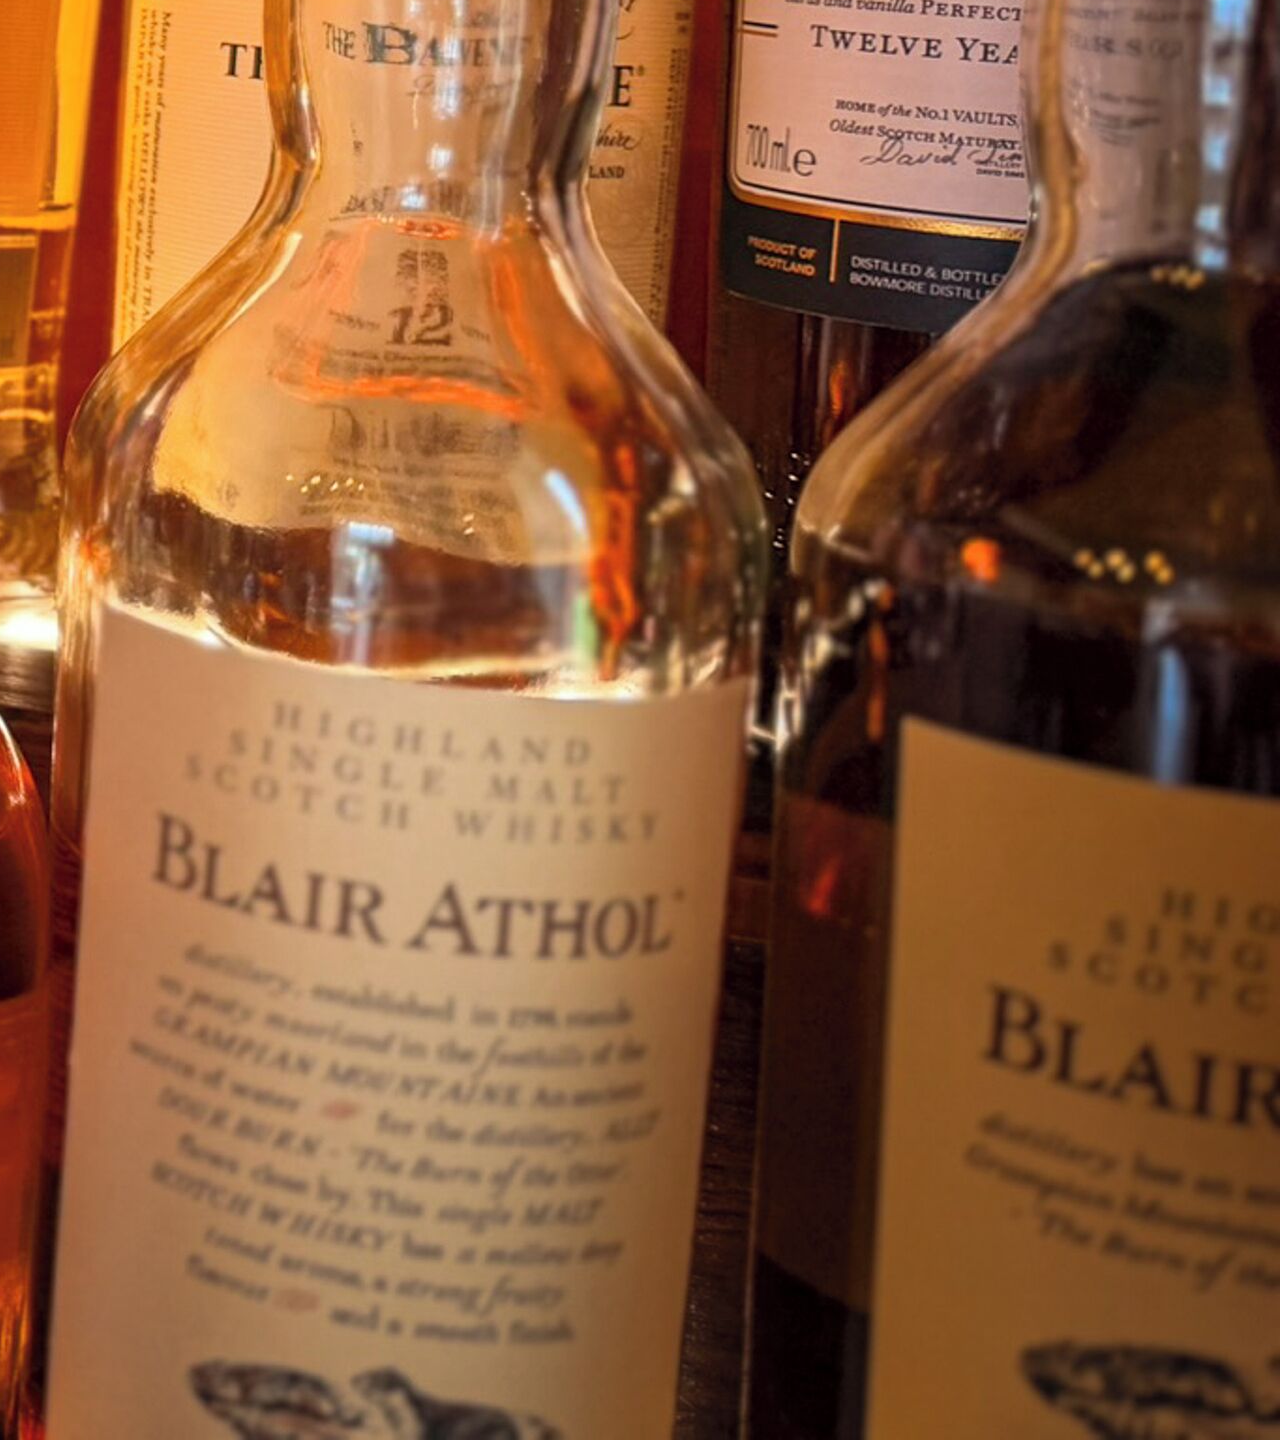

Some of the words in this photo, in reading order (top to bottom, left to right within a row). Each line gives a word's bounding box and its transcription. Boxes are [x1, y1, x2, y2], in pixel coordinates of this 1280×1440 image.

[810, 24, 943, 59] TWELVE
[829, 119, 874, 139] Oldest
[836, 99, 876, 116] HOME
[850, 254, 922, 278] DISTILLED
[850, 273, 927, 295] BOWMORE
[272, 700, 592, 767] HIGHLAND
[228, 725, 446, 797] SINGLE
[488, 772, 627, 806] MALT
[182, 754, 412, 832] SCOTCH
[454, 807, 662, 846] WHISKY
[150, 810, 391, 947] BLAIR
[405, 880, 674, 961] ATHOL
[981, 983, 1280, 1130] BLAIR
